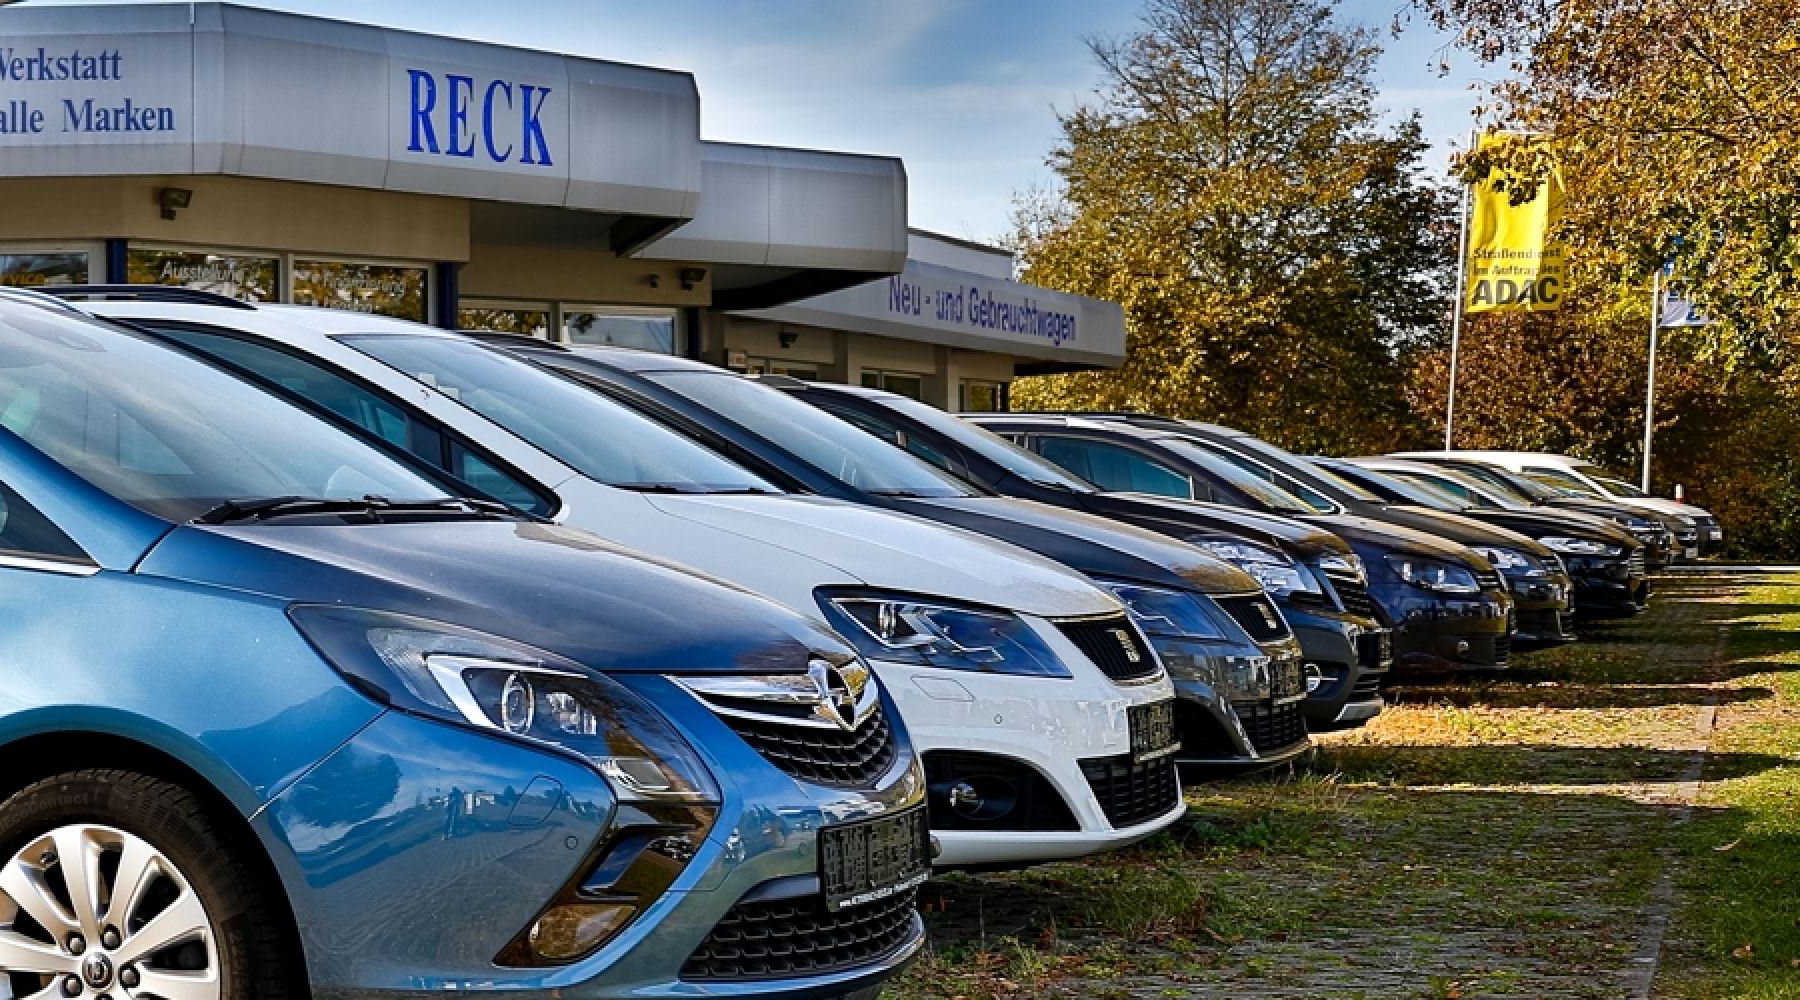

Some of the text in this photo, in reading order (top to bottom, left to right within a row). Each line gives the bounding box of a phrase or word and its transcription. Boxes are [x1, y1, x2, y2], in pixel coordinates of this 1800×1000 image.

[62, 98, 174, 132] Marken
[406, 68, 553, 166] RECK
[889, 275, 920, 316] Neu
[935, 286, 963, 324] und
[969, 287, 1077, 346] Gebrauchtwagen
[1472, 276, 1559, 305] ADAC
